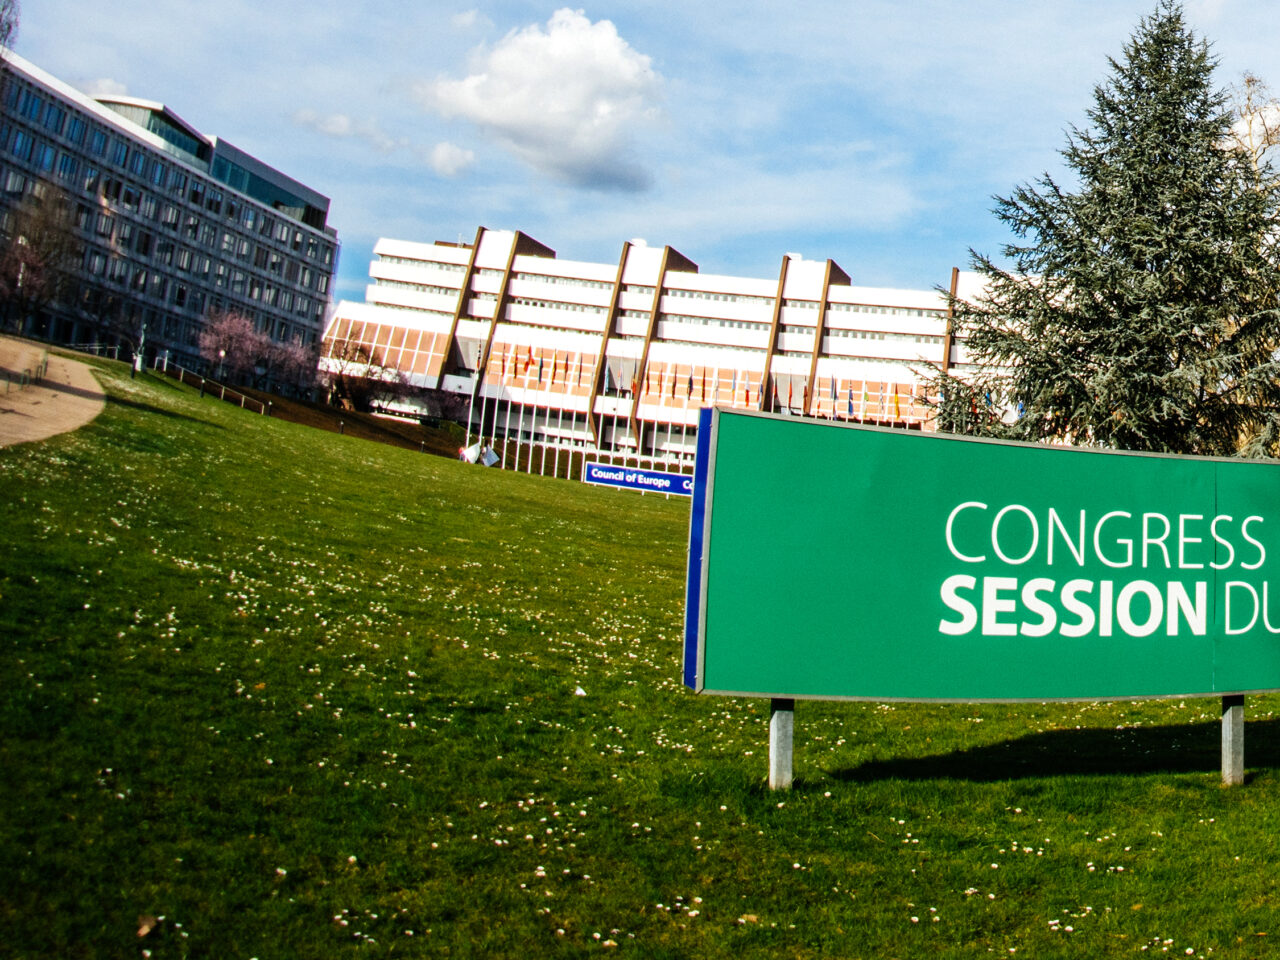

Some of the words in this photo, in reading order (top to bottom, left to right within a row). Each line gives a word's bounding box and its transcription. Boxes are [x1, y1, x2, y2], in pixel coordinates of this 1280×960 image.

[591, 468, 624, 481] Council
[625, 472, 637, 483] of
[637, 474, 671, 488] Europe
[945, 501, 1266, 570] CONGRESS
[938, 574, 1207, 638] SESSION
